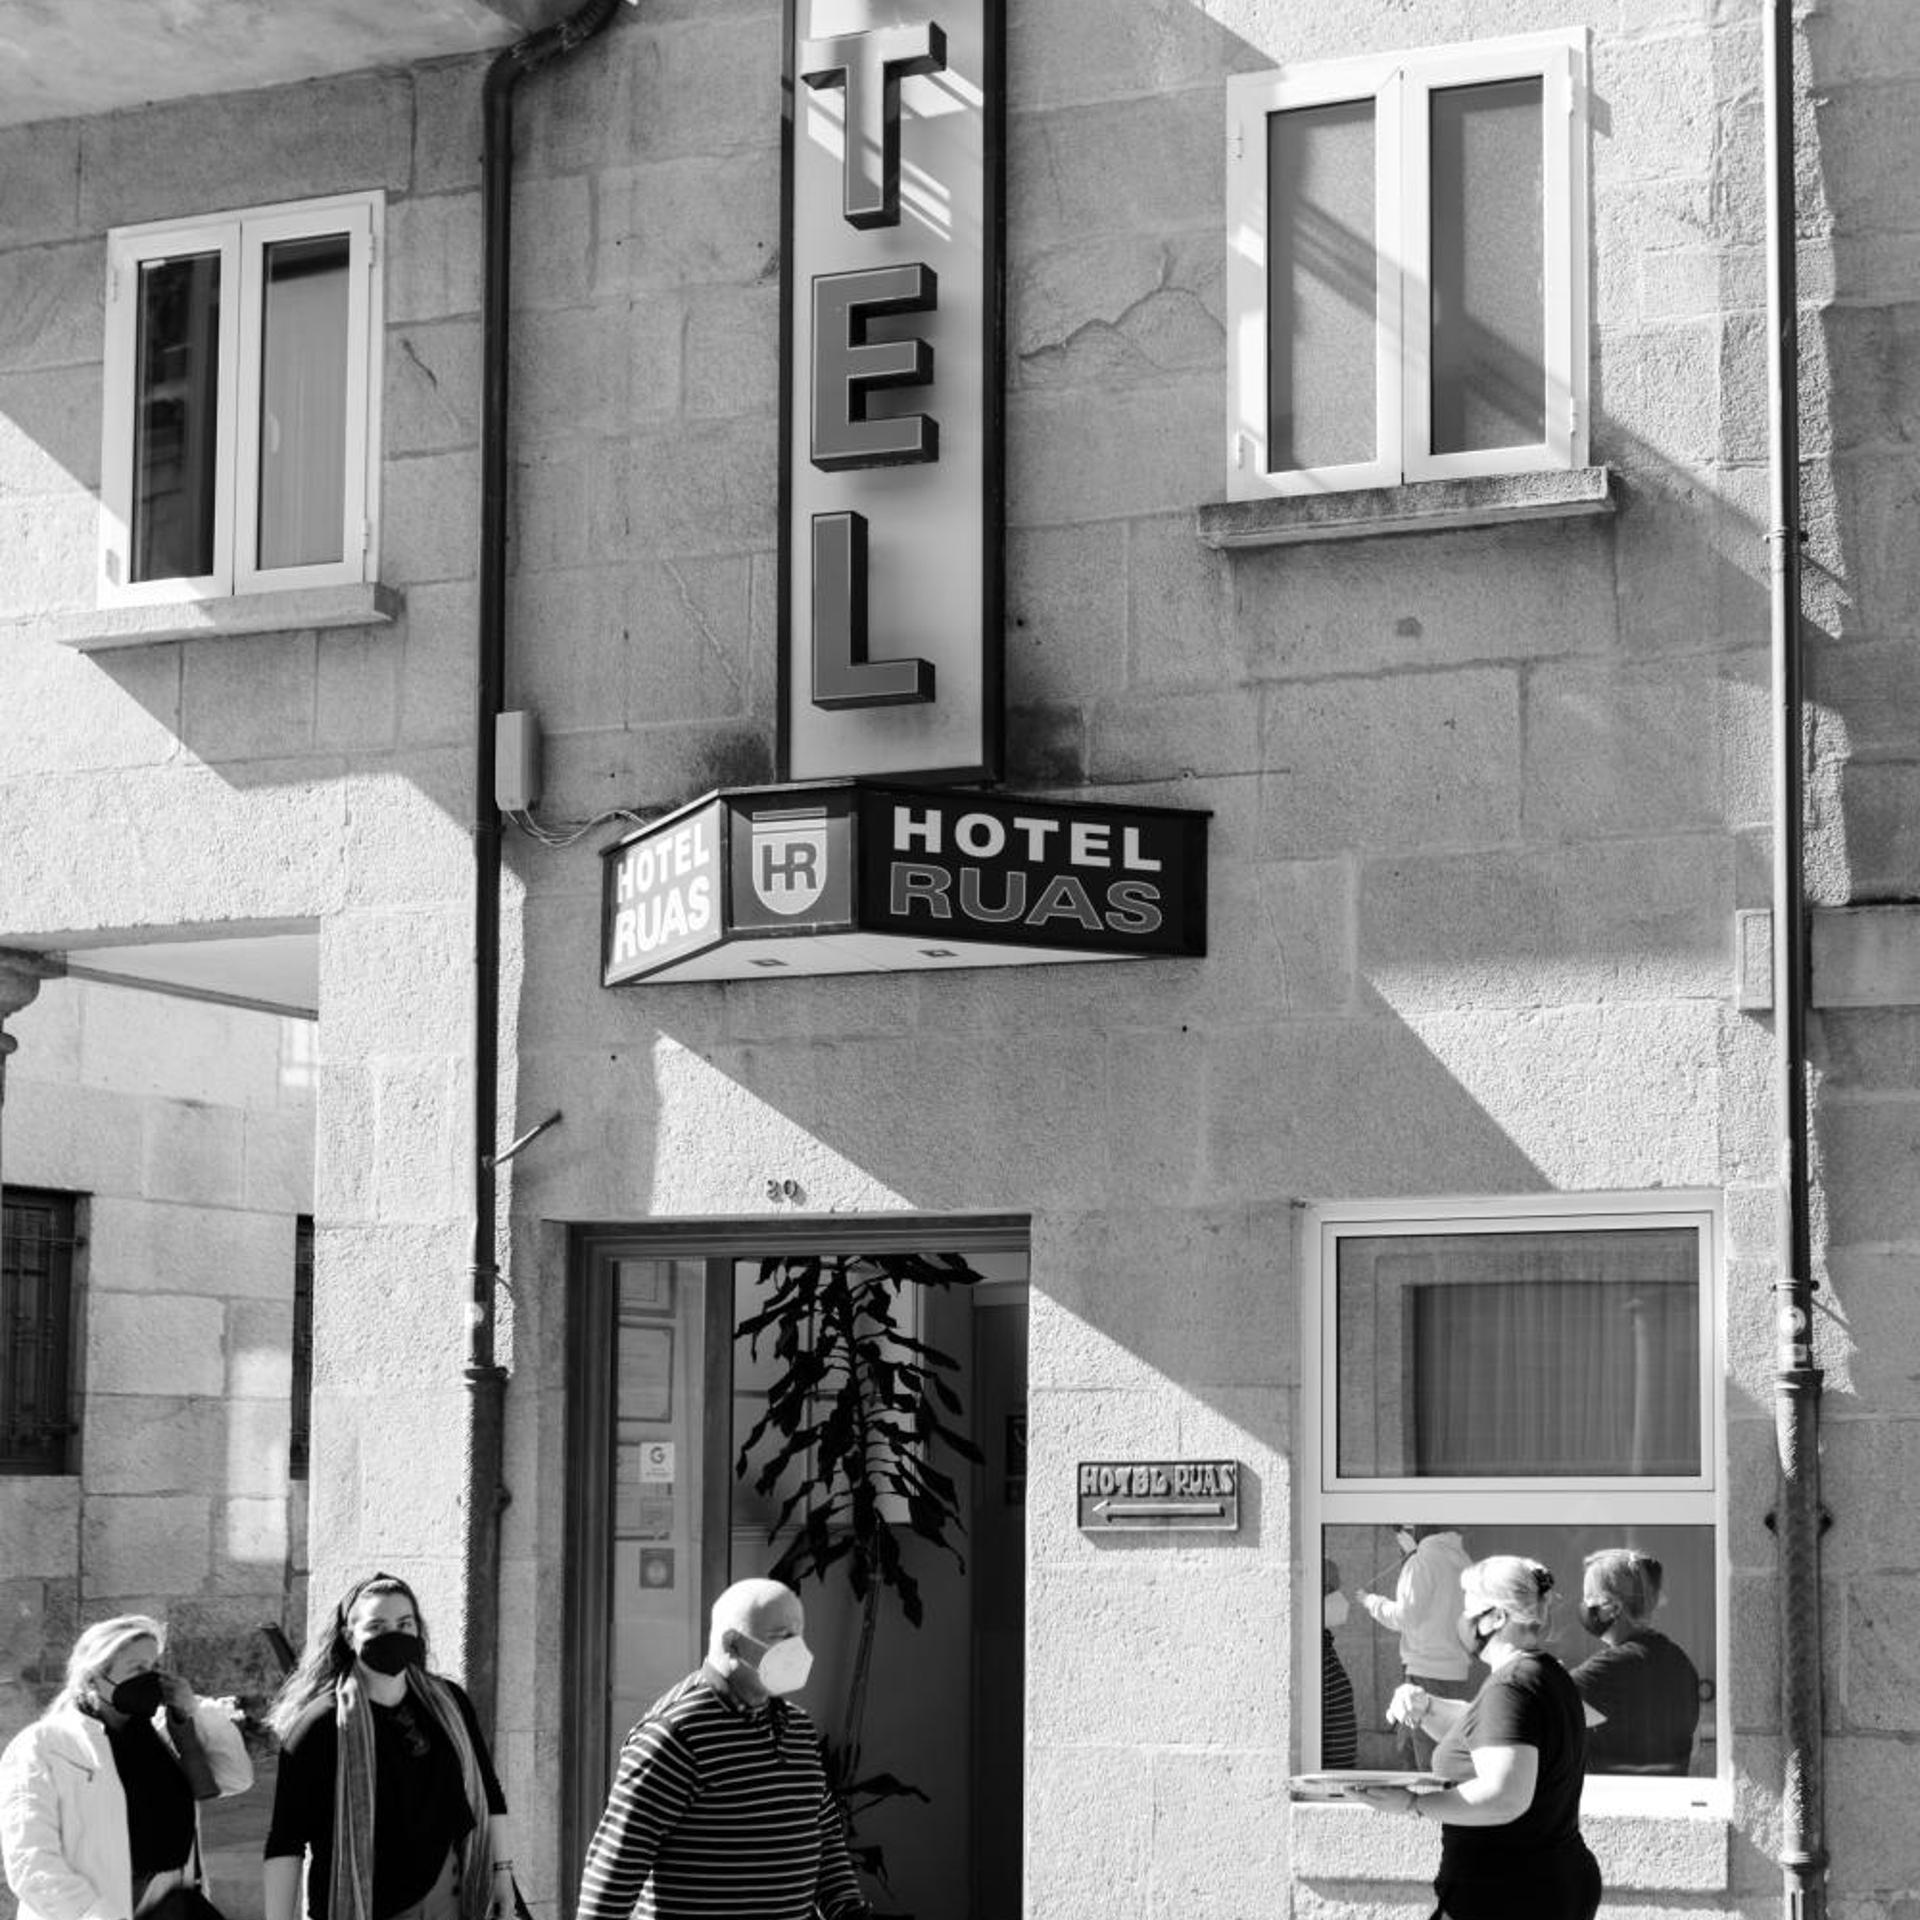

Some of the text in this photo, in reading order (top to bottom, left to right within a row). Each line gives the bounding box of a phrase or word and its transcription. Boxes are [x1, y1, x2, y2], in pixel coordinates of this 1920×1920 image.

[617, 822, 710, 904] HOTEL
[761, 842, 818, 892] HR
[893, 805, 1162, 872] HOTEL
[613, 875, 710, 964] RUAS
[889, 861, 1163, 933] RUAS
